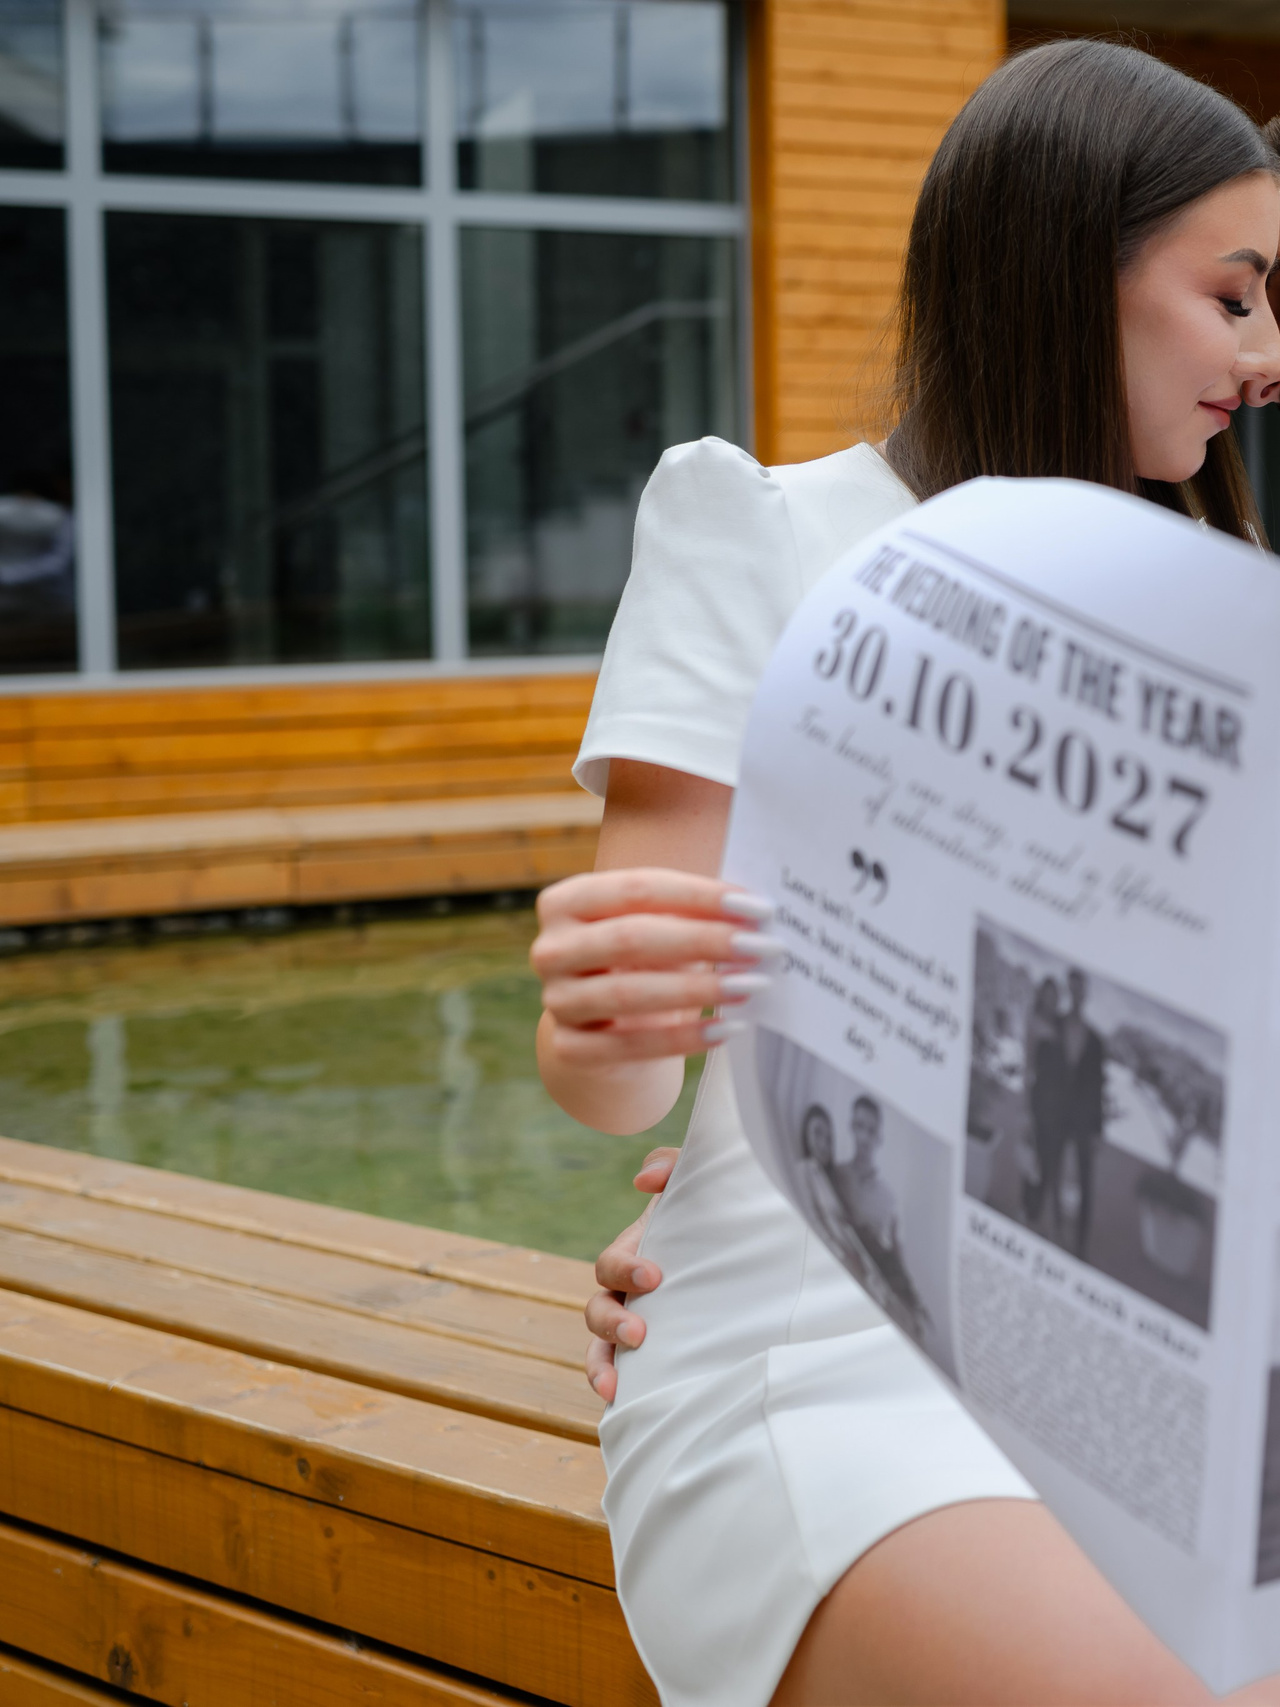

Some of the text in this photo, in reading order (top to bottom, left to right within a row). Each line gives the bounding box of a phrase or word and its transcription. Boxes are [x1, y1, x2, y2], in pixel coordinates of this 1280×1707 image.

[813, 607, 1211, 859] 30.10.2027
[853, 545, 1245, 769] THE WEDDING OF THE YEAR
